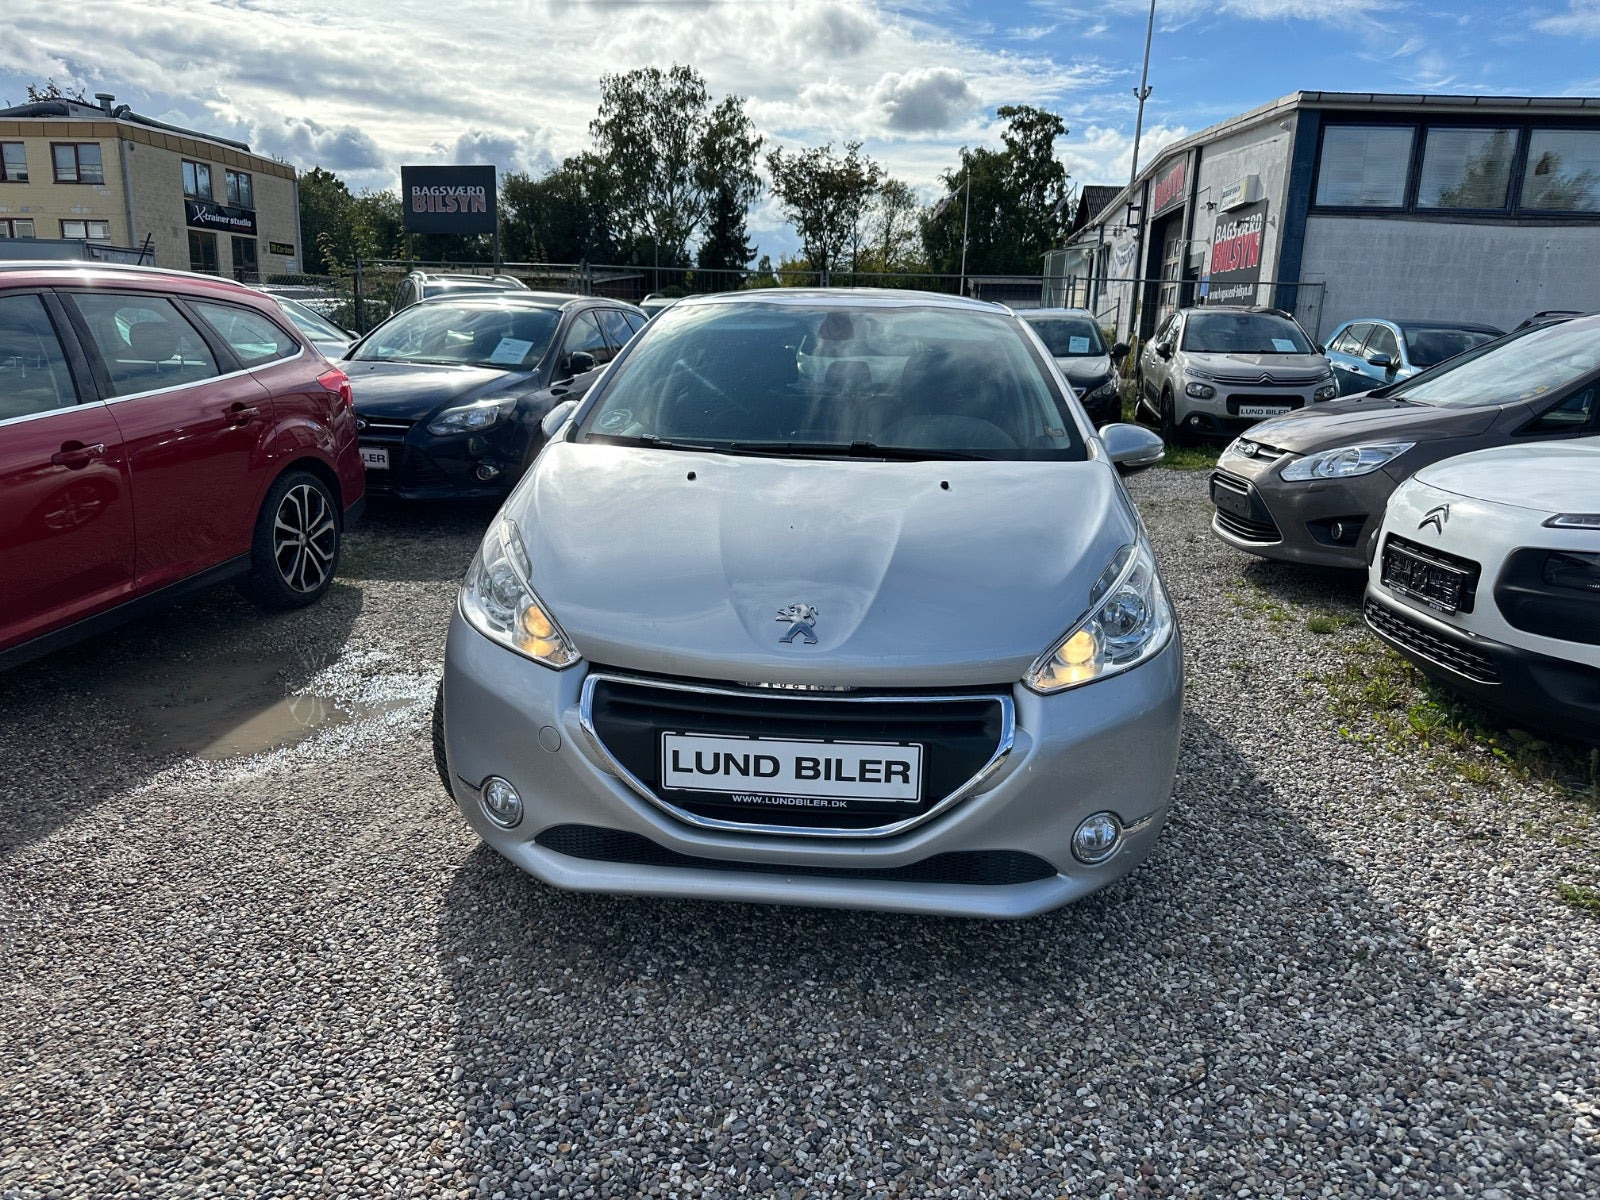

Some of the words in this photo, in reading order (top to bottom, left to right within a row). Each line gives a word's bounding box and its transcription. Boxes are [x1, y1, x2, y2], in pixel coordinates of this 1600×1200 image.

[412, 186, 485, 195] BAGSVÆRD
[412, 194, 487, 213] BILSYN
[193, 204, 230, 224] X-trainer
[230, 216, 252, 227] studio
[1211, 231, 1260, 274] BILSYN
[362, 453, 385, 463] LER
[672, 749, 781, 779] LUND
[794, 756, 911, 784] BILER
[731, 794, 848, 808] WWW.LUNDBILER.DK
